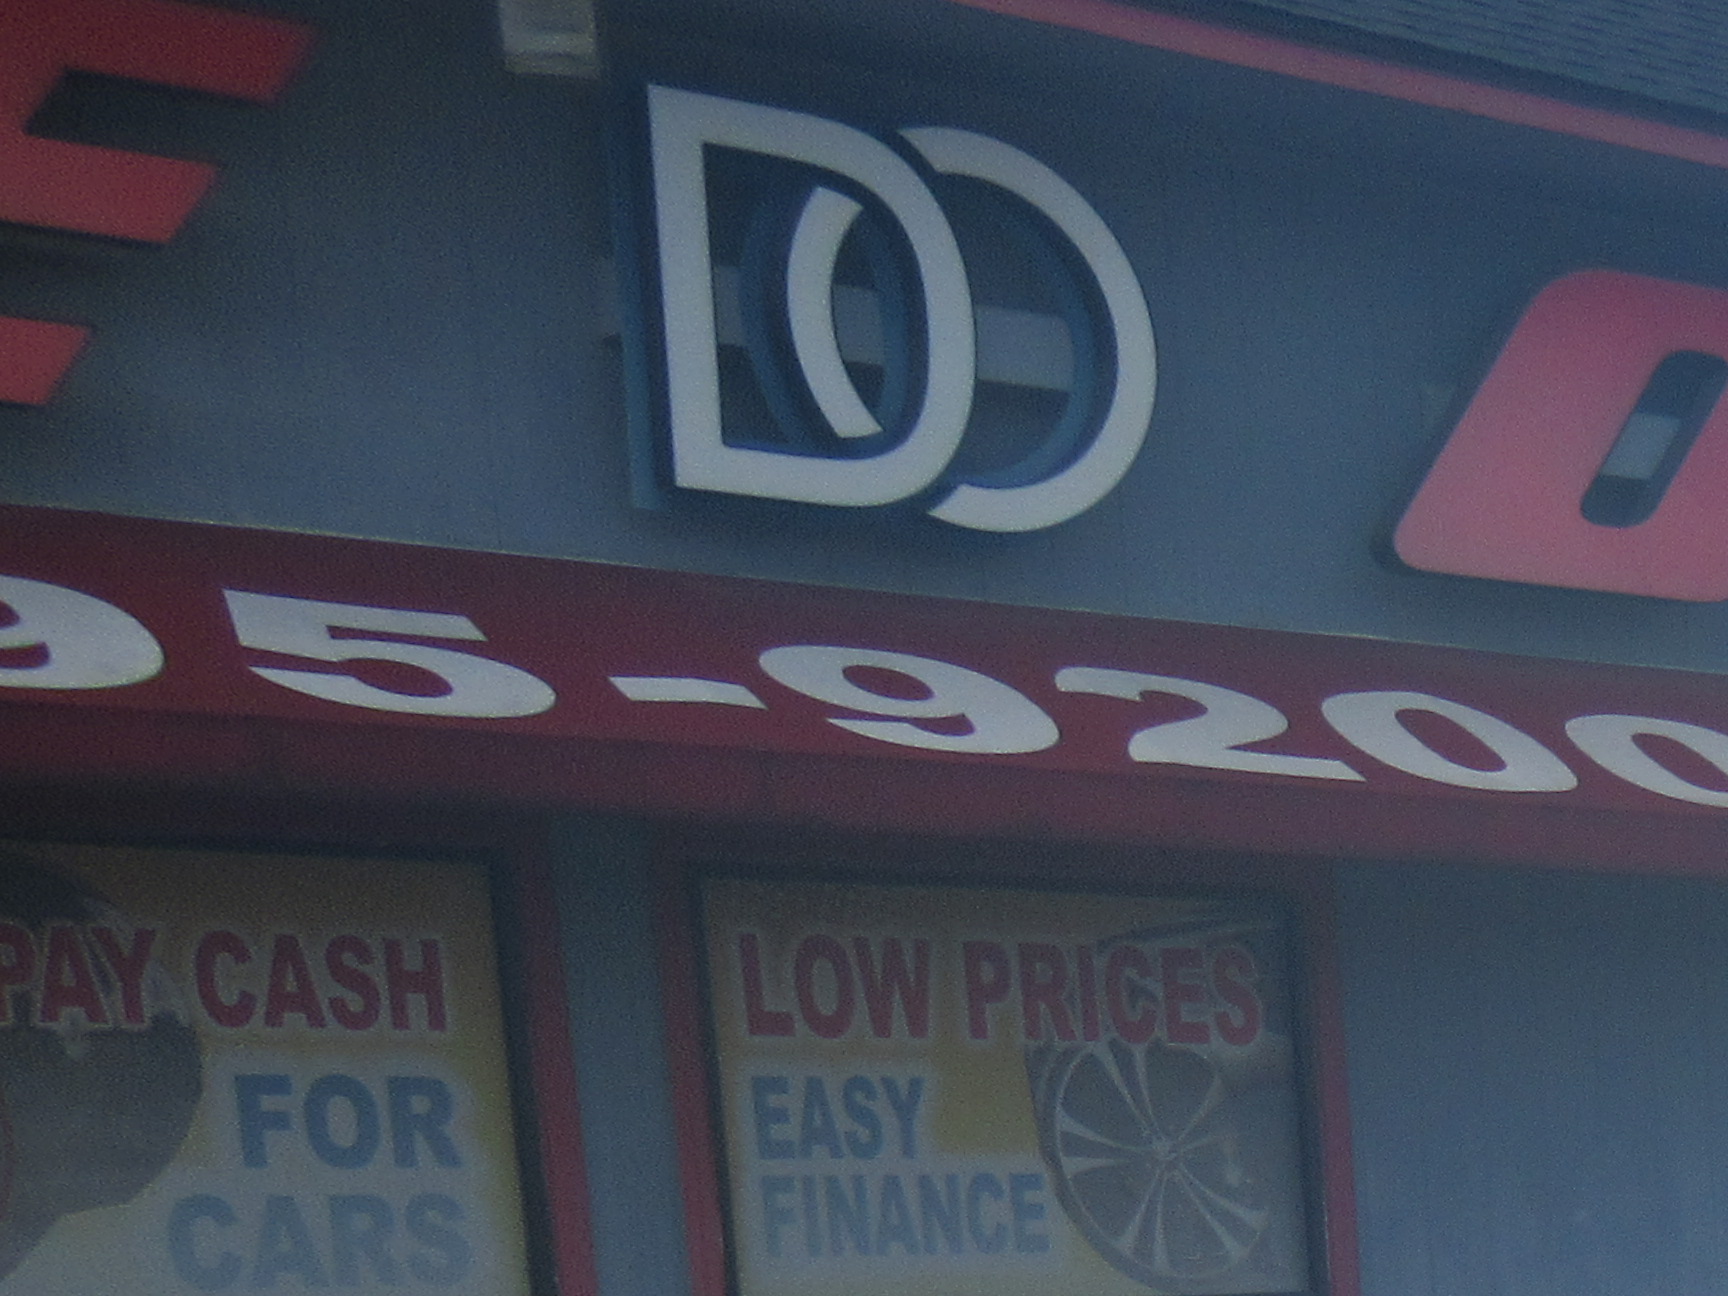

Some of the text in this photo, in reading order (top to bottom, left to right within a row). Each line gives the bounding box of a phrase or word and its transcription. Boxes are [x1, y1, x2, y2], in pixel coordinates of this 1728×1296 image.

[194, 929, 447, 1032] CASH
[738, 931, 1262, 1047] LOW PRICES
[233, 1073, 464, 1170] FOR
[750, 1074, 926, 1161] EASY
[166, 1191, 475, 1293] CARS
[760, 1171, 1054, 1259] FINANCE
